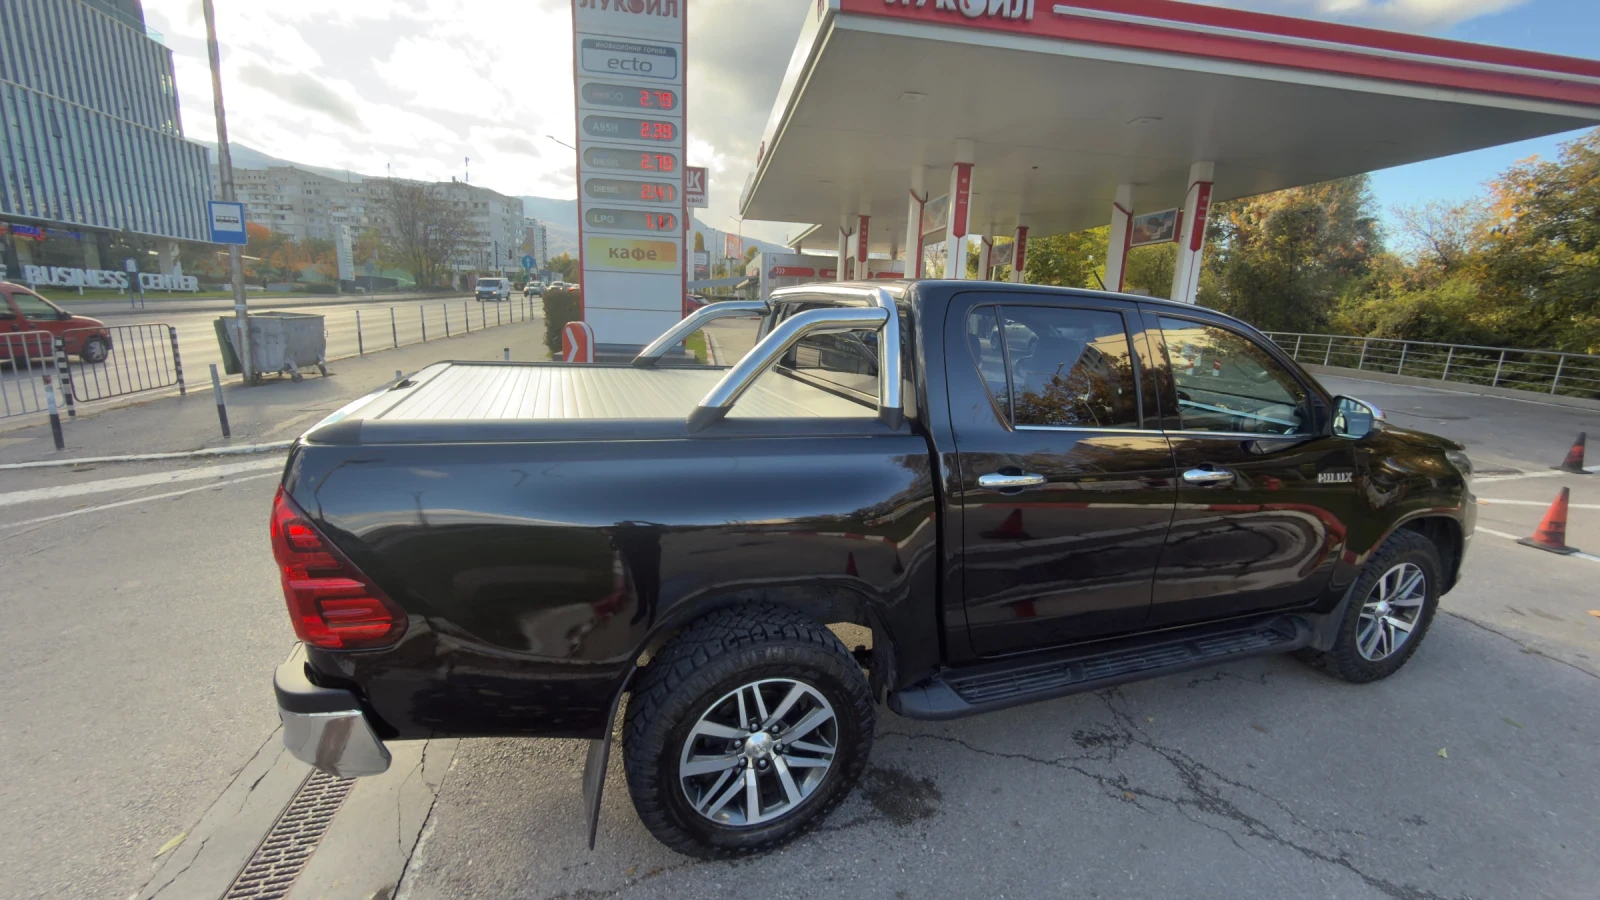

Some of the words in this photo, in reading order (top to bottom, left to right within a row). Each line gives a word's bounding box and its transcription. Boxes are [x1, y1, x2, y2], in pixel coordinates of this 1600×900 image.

[643, 46, 667, 54] ГОРИВА
[607, 57, 653, 73] ecto
[640, 90, 673, 109] 2.79
[641, 122, 673, 140] 2.39
[592, 157, 621, 167] DIESEL
[641, 153, 673, 171] 2.79
[593, 185, 620, 194] DIESEL
[641, 184, 673, 200] 2.41
[594, 214, 615, 224] LPG
[608, 247, 657, 261] кафе
[24, 265, 128, 289] BUSINESS
[138, 272, 199, 291] CENTER
[1318, 472, 1353, 483] HILUX
